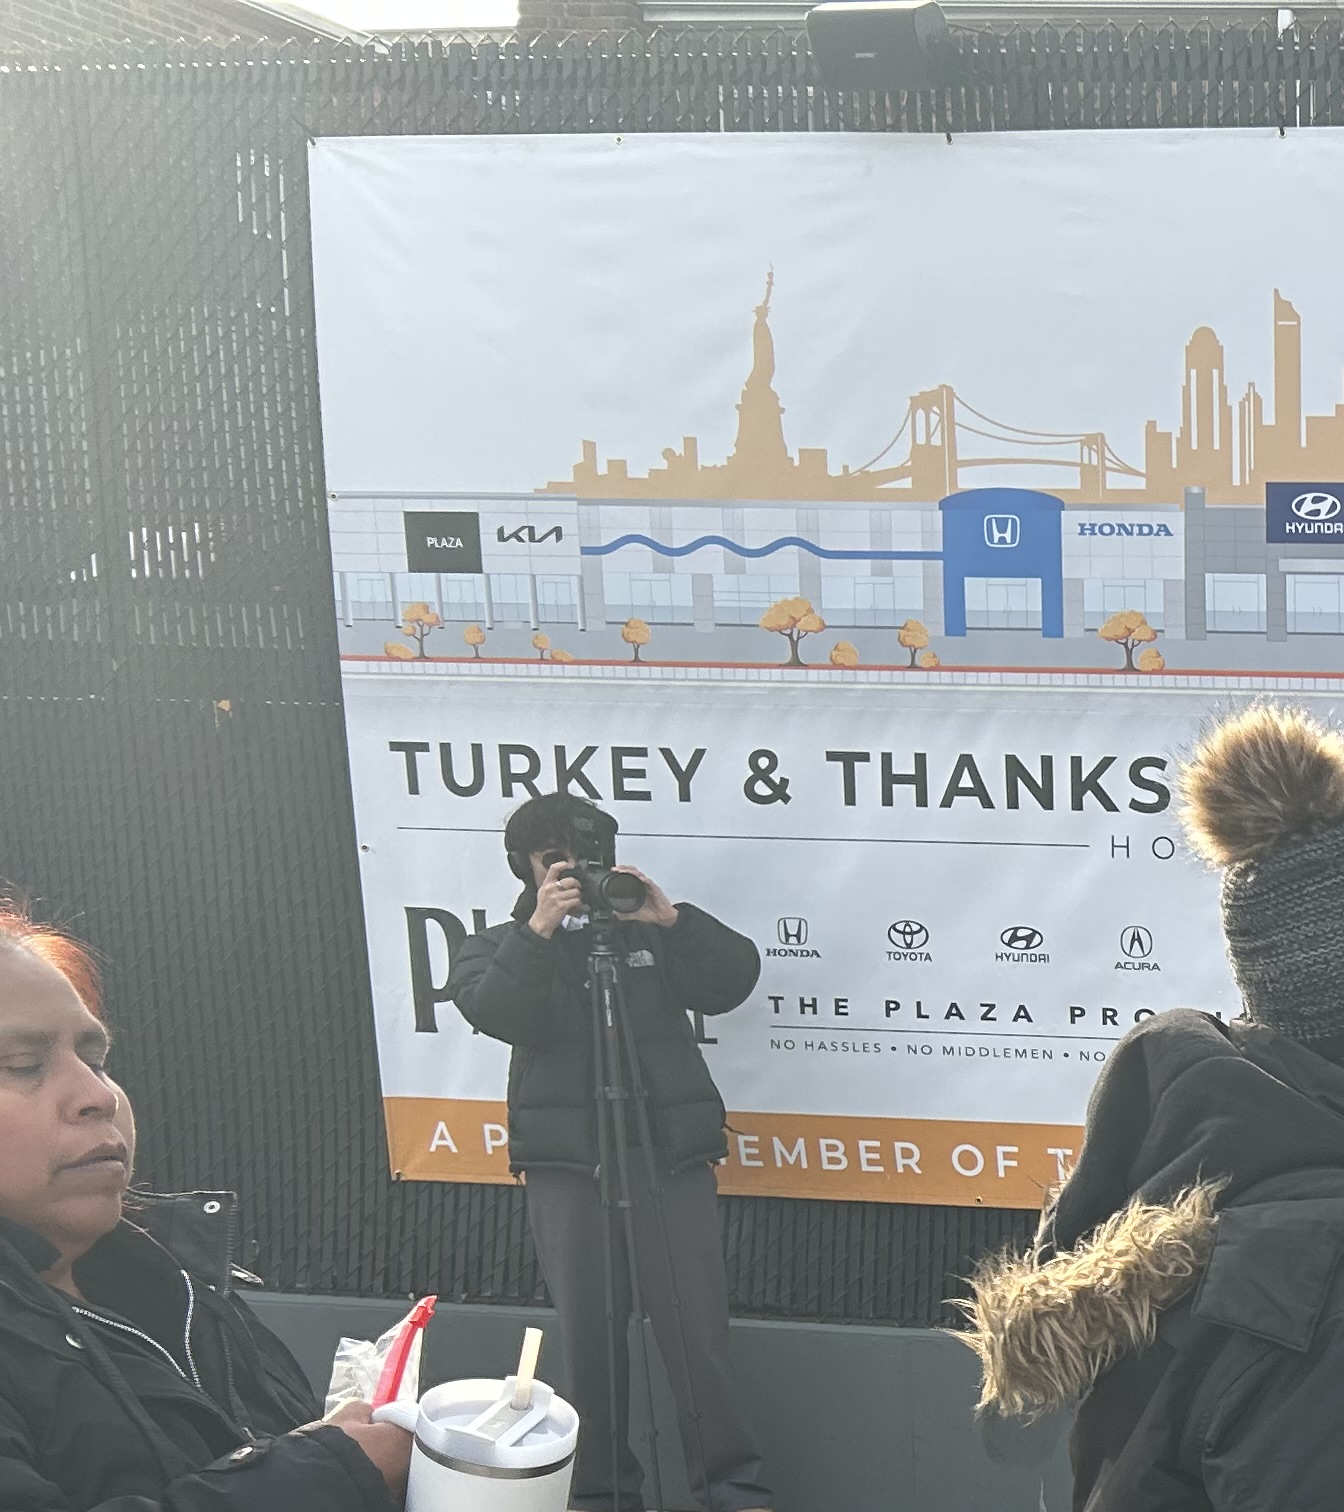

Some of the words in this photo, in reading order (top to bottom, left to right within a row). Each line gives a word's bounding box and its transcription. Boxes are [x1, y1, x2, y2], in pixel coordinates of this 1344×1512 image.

[496, 525, 564, 544] KIA
[1077, 521, 1174, 539] HONDA
[427, 536, 464, 549] PLAZA
[389, 741, 707, 803] TURKEY
[743, 748, 792, 805] &
[766, 948, 822, 959] HONDA
[886, 951, 933, 963] TOYOTA
[995, 953, 1050, 964] HYUNDAI
[1115, 961, 1161, 972] ACURA
[768, 995, 849, 1017] THE
[885, 1000, 1034, 1023] PLAZA
[770, 1039, 796, 1051] NO
[805, 1041, 882, 1054] HASSLES
[907, 1044, 933, 1056] NO
[942, 1046, 1054, 1061] MIDDLEMEN
[1079, 1050, 1106, 1062] NO
[429, 1121, 458, 1153] A
[737, 1135, 923, 1175] EMBER
[952, 1143, 1020, 1179] OF
